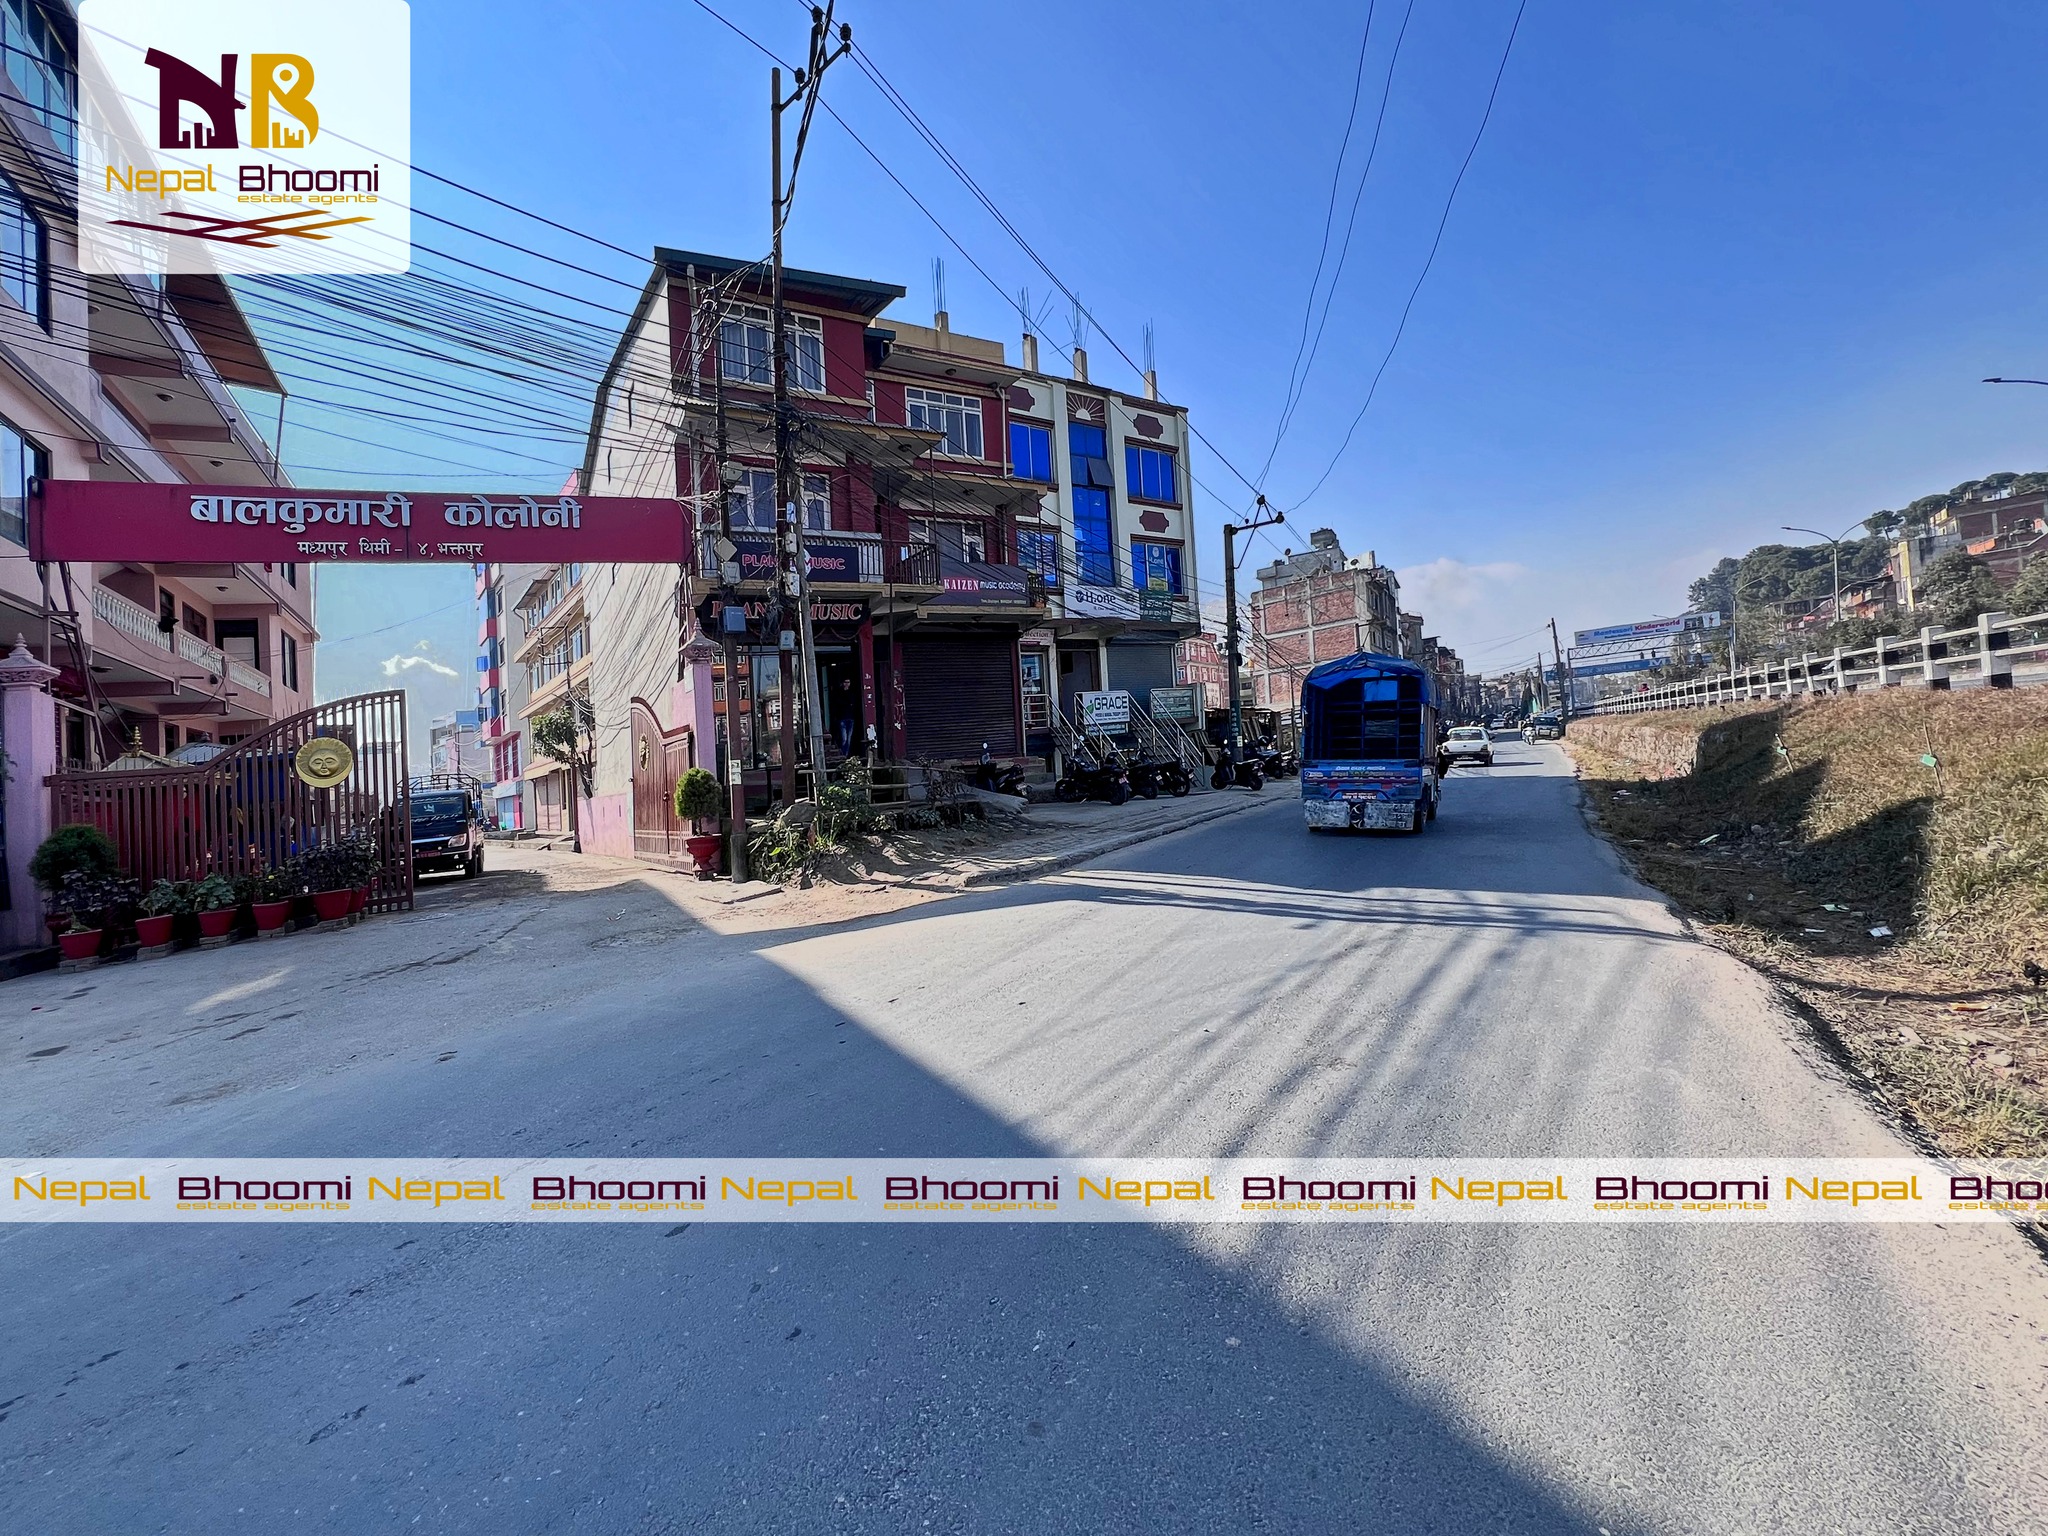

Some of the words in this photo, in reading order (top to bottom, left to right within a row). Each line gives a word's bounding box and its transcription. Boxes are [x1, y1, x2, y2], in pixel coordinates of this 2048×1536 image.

[190, 492, 414, 534] बालकुमारी
[444, 494, 583, 529] कोलोनी
[297, 541, 348, 559] मध्यपुर
[437, 542, 484, 560] भक्तपुर
[741, 553, 788, 568] PLAN
[804, 556, 846, 570] MUSIC
[943, 578, 979, 591] KAIZEN
[1593, 625, 1633, 637] Montessori
[1634, 618, 1681, 631] Kinderworld
[1094, 695, 1128, 710] GRACE
